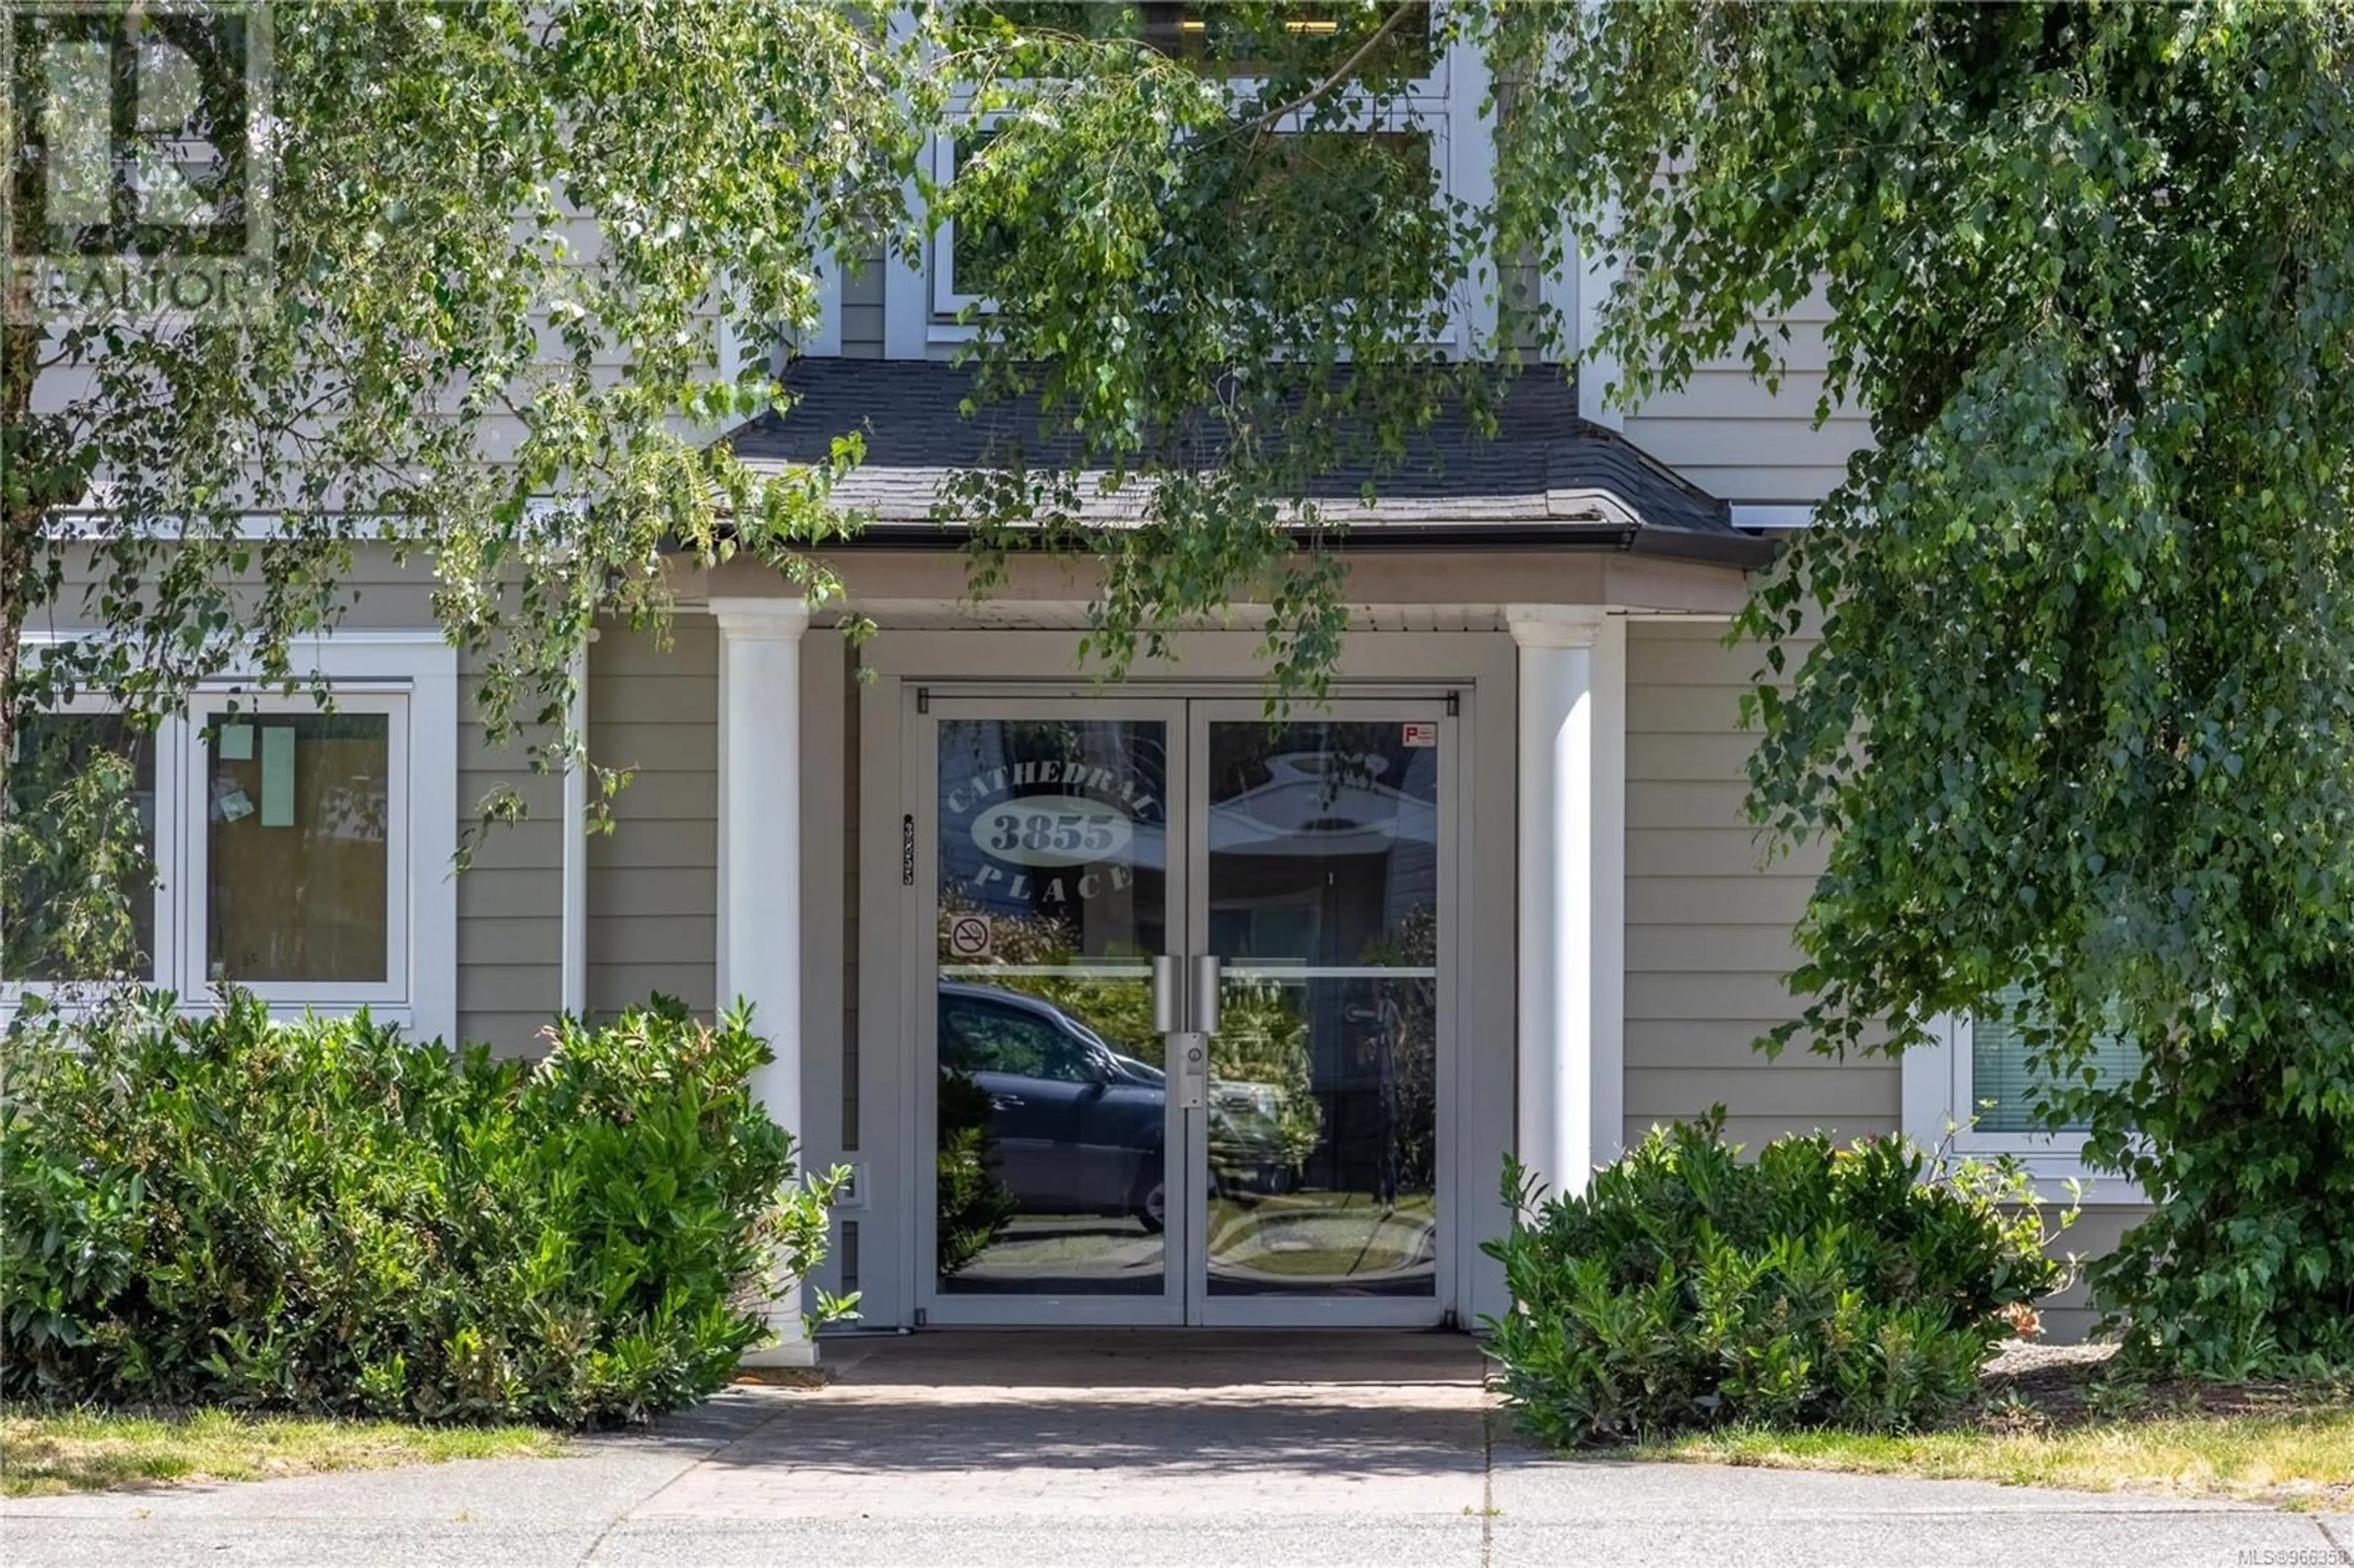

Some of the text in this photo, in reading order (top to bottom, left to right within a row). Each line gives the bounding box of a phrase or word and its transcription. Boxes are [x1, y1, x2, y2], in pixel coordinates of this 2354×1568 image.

[948, 759, 1157, 818] CATHEDRAL
[991, 814, 1114, 850] 3855
[973, 863, 1133, 902] PLACE
